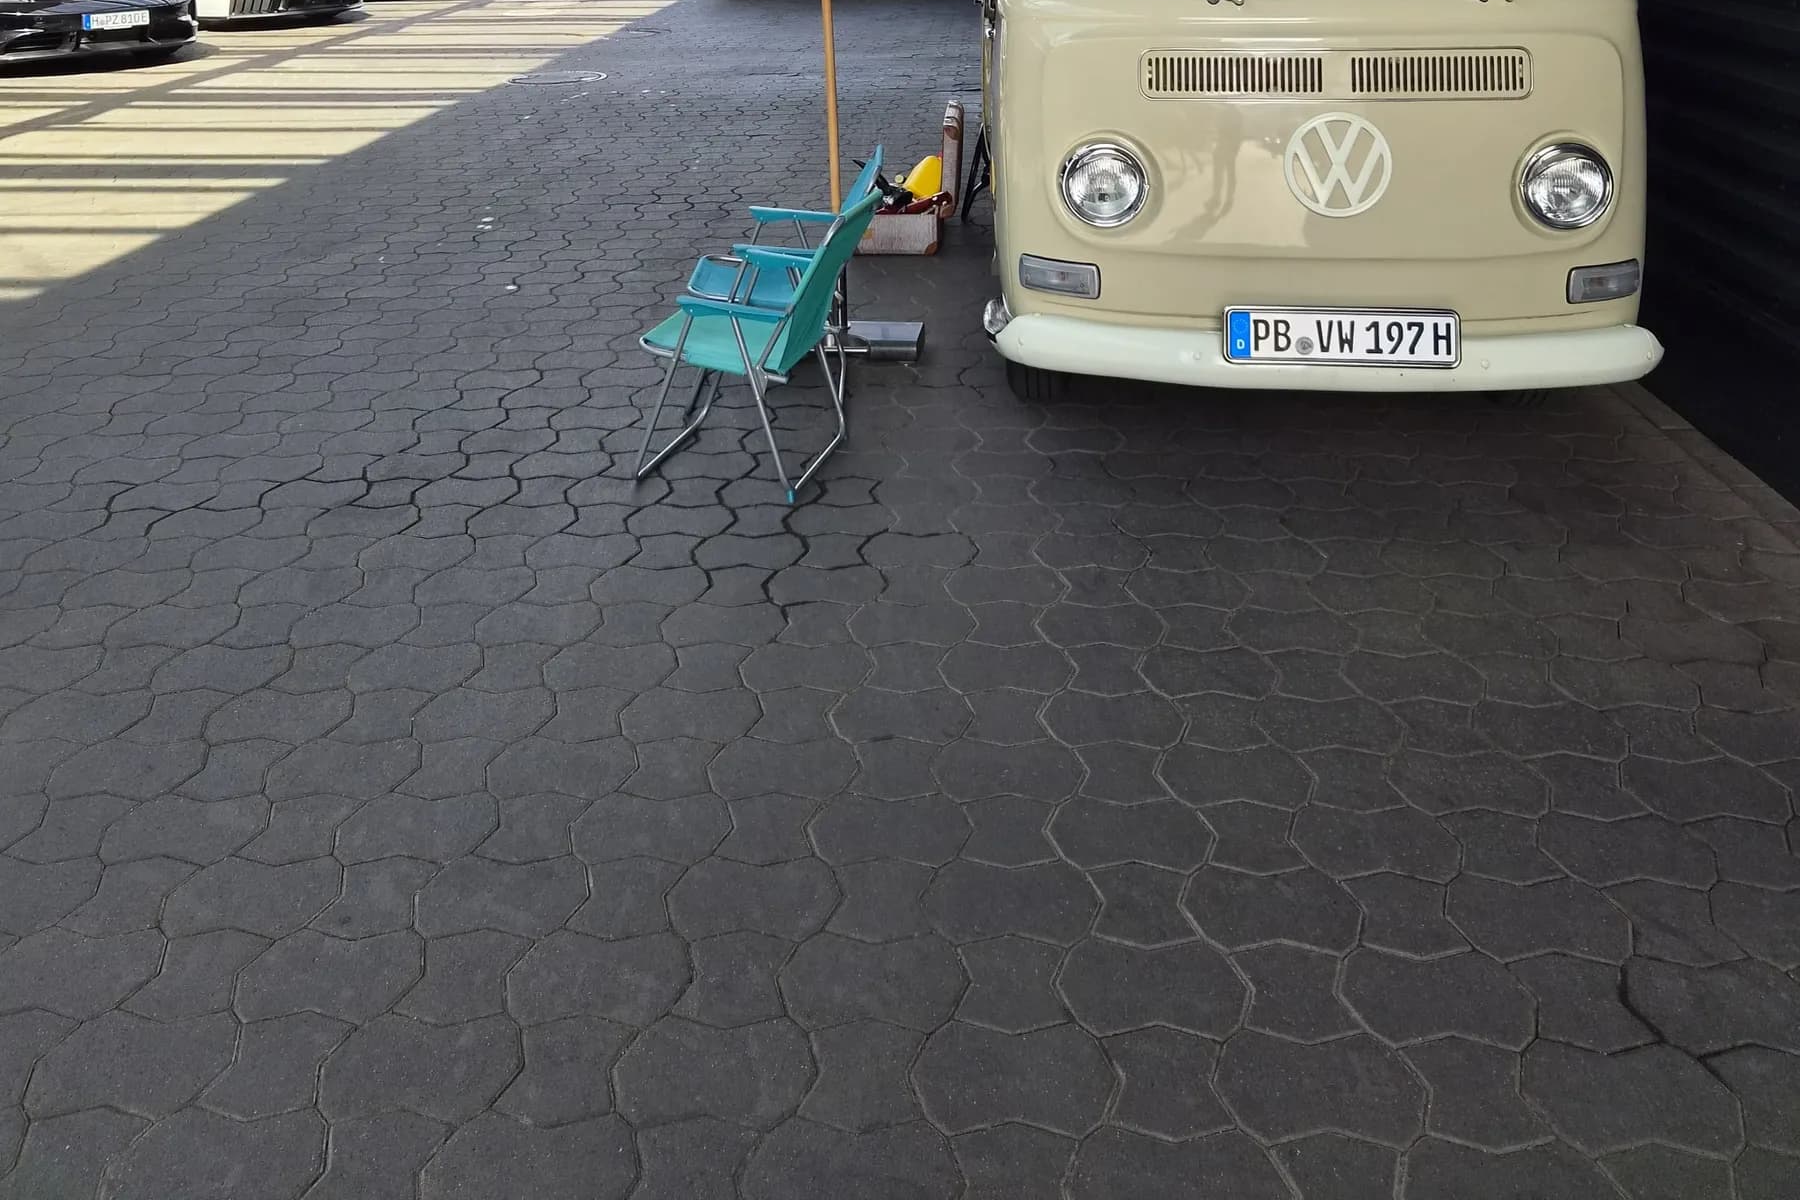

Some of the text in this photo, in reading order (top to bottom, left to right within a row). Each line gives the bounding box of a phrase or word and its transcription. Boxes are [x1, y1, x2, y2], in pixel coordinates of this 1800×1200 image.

[92, 16, 99, 25] H
[105, 14, 119, 25] PZ
[1253, 319, 1291, 352] PB
[1315, 320, 1355, 354] VW
